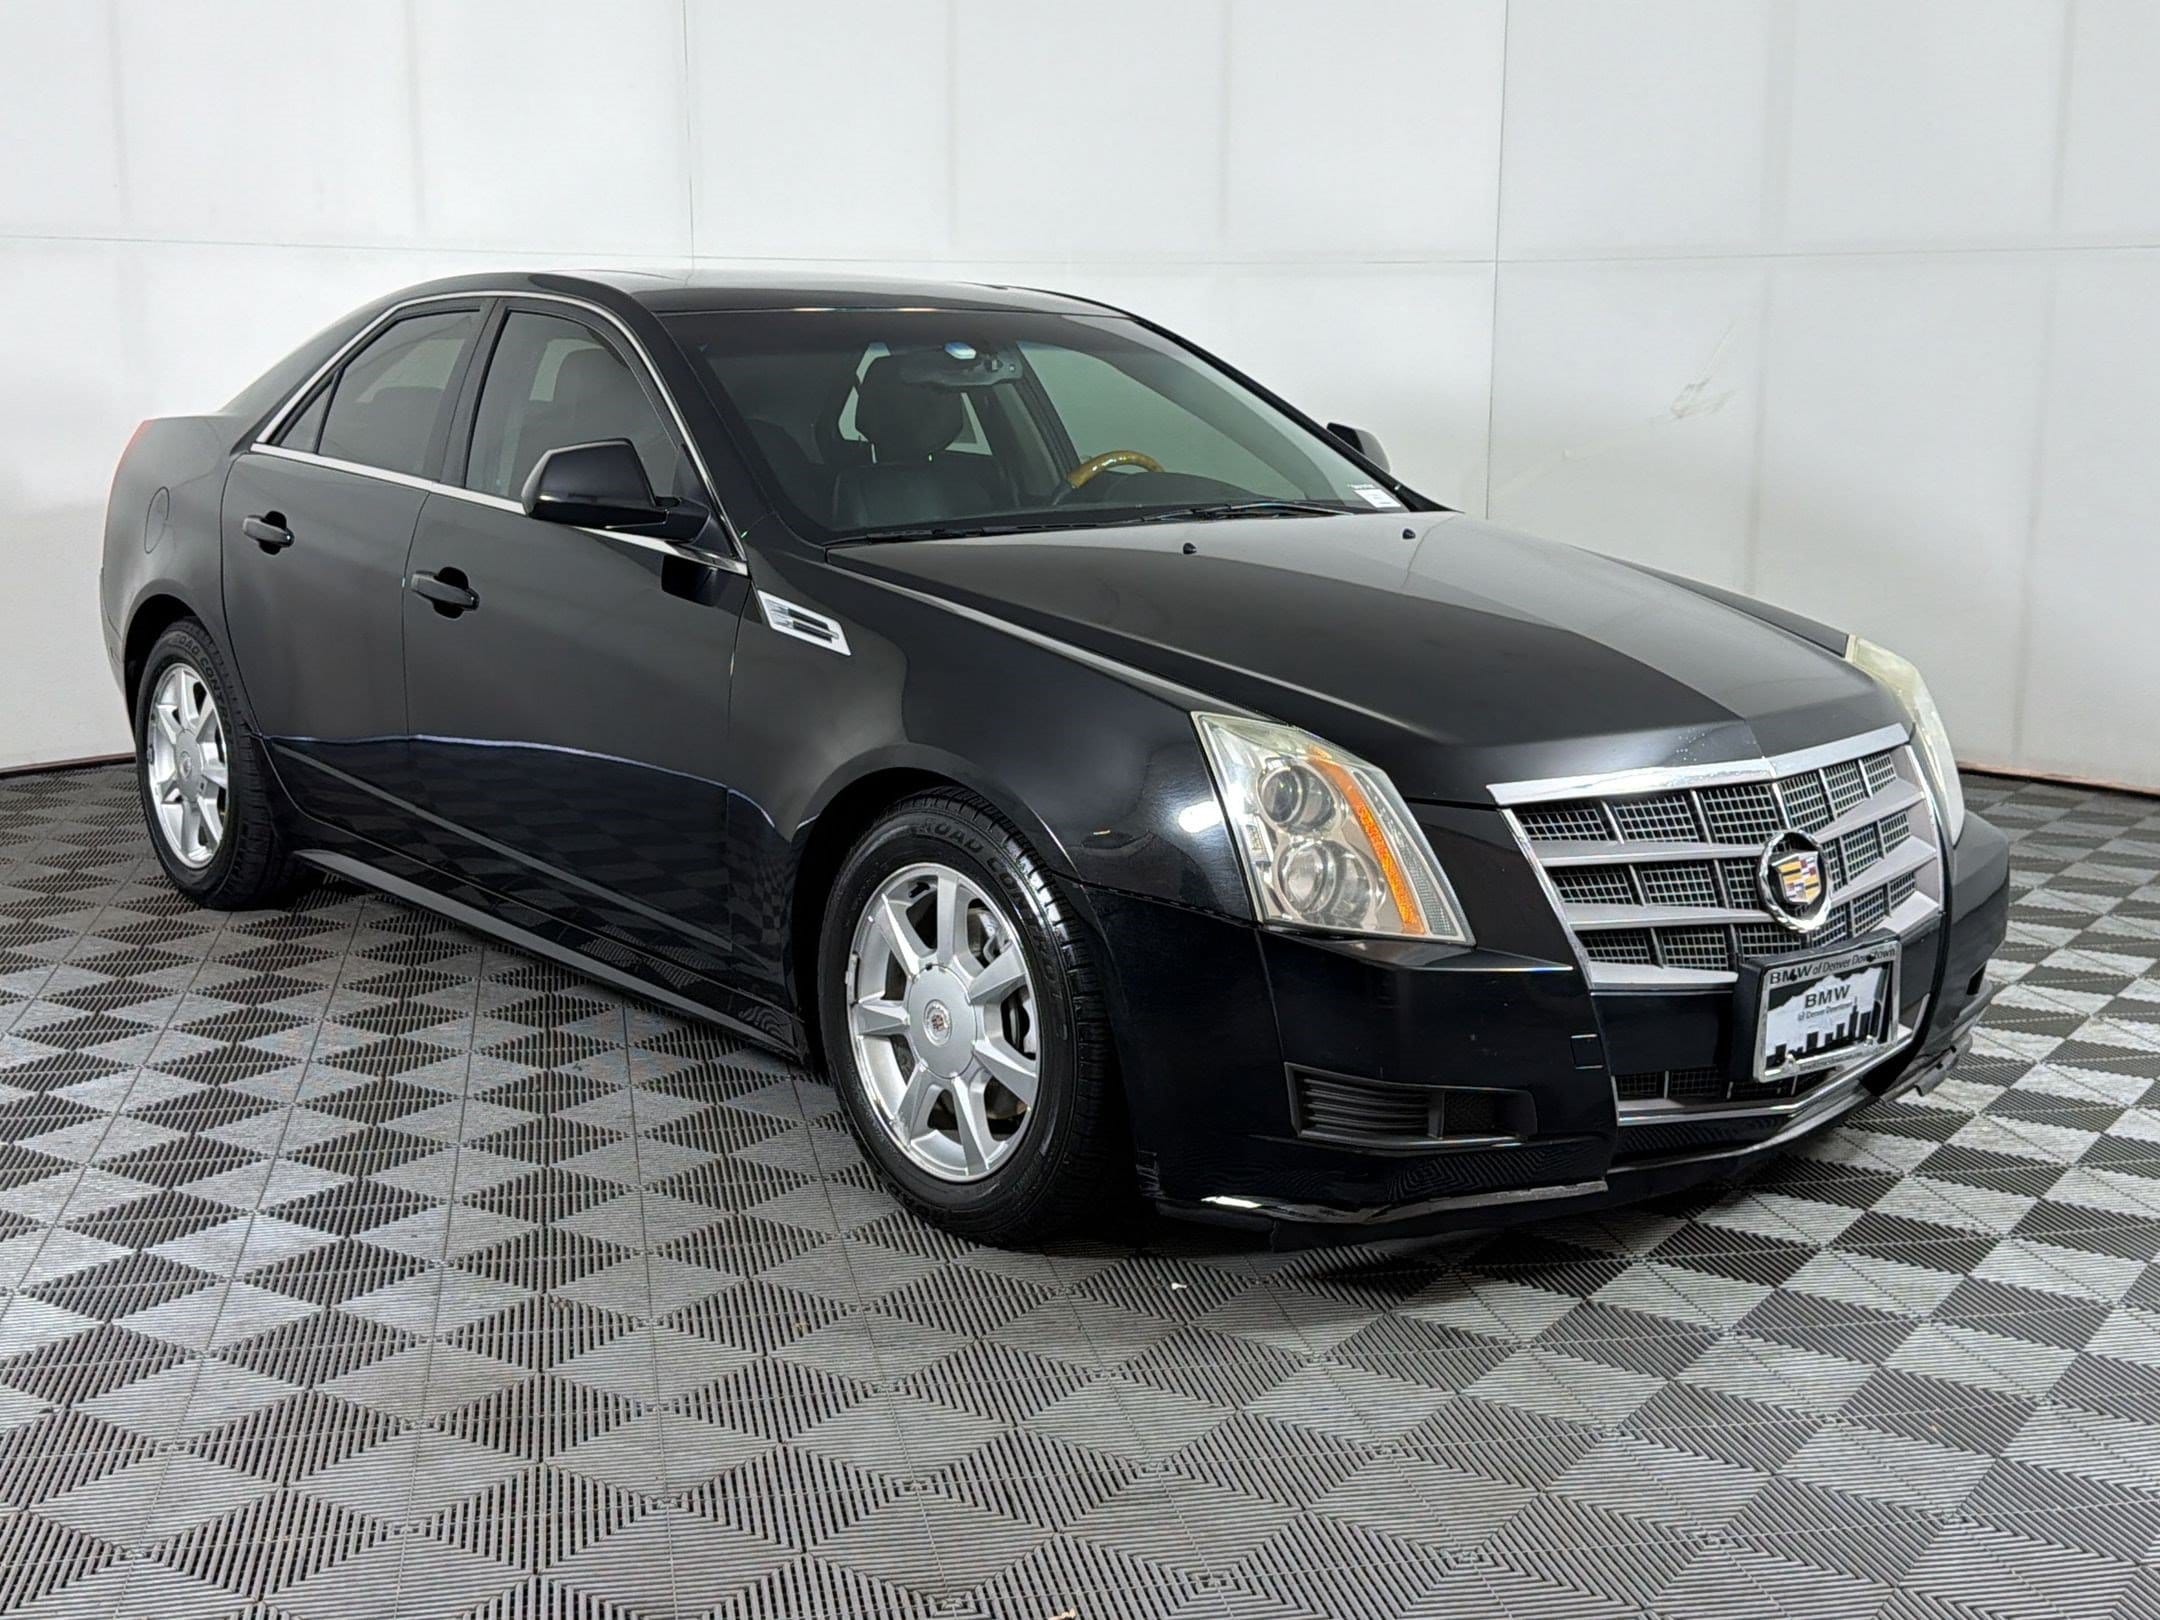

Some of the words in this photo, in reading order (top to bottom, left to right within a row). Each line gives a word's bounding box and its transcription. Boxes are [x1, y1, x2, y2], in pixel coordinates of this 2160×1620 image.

[173, 633, 200, 655] OAD
[1770, 965, 1812, 985] BMW
[1813, 963, 1823, 975] of
[1822, 960, 1851, 973] Denver
[1851, 948, 1895, 965] Dowtown
[1805, 984, 1850, 1008] BMW
